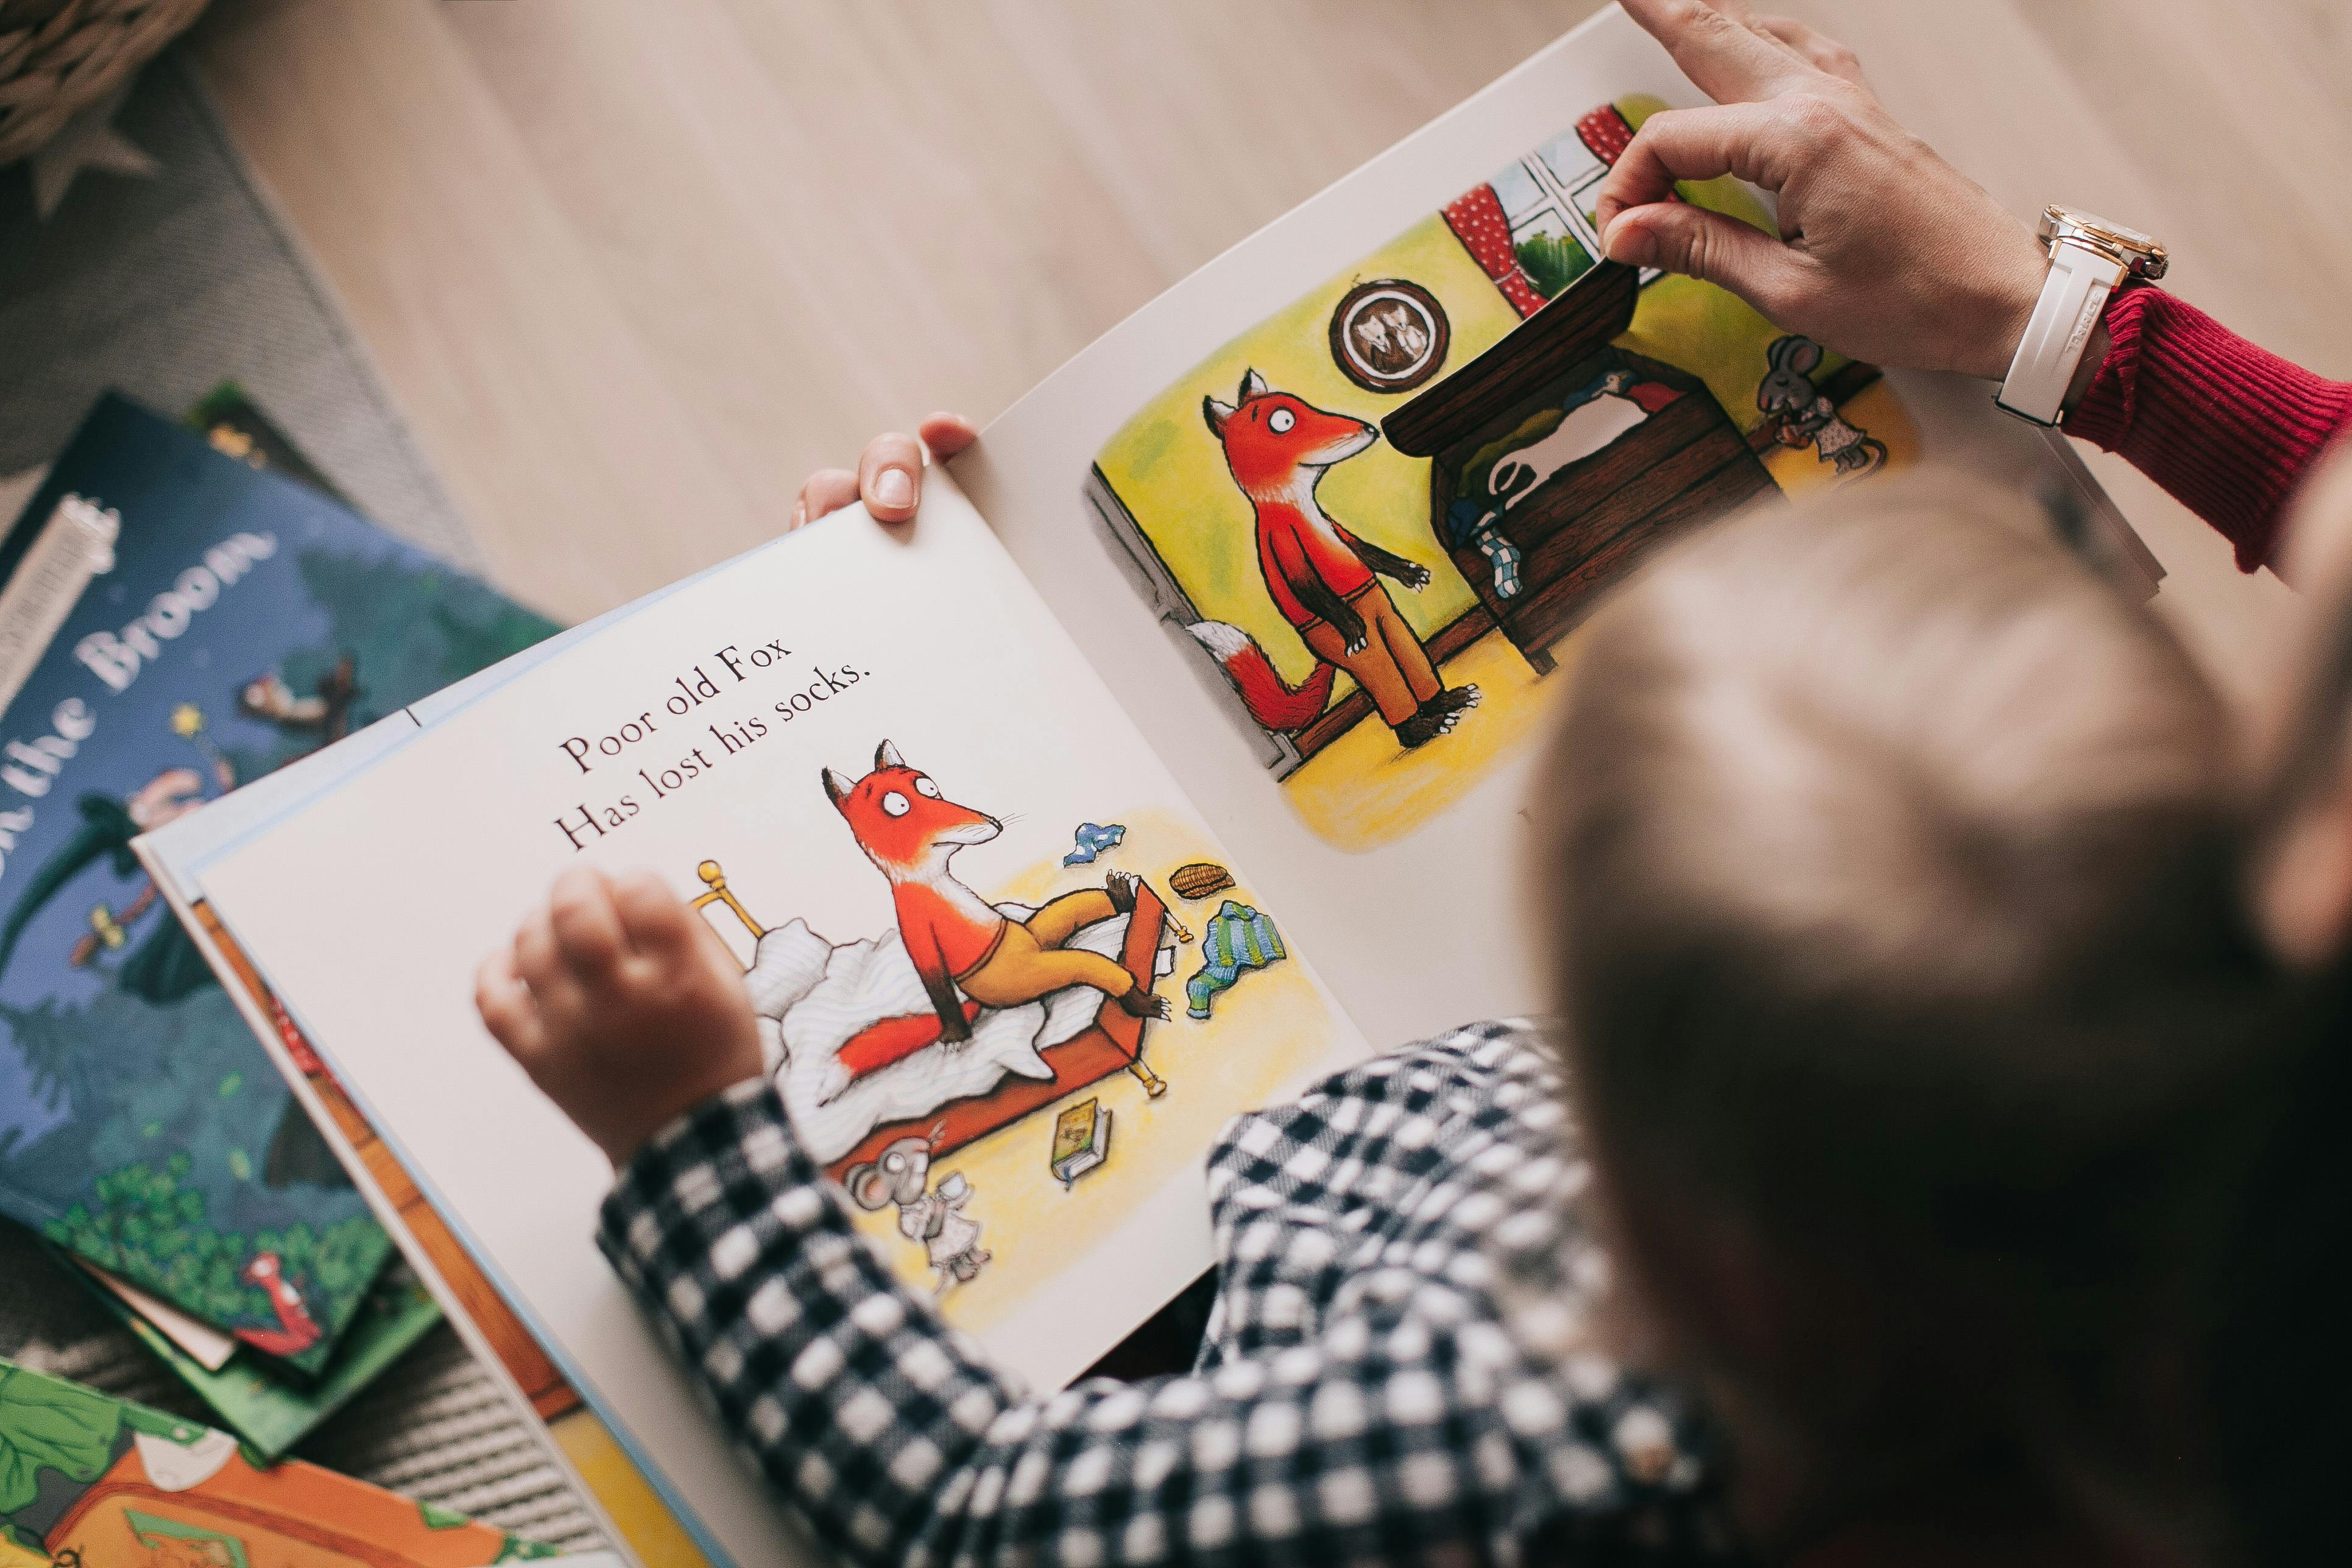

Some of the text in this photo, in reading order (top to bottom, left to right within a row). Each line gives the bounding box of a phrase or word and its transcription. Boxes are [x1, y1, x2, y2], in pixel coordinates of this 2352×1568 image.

[1, 698, 96, 796] the
[74, 532, 277, 692] Broom
[554, 664, 871, 851] Has lost his socks.
[558, 639, 792, 775] Poor old Fox
